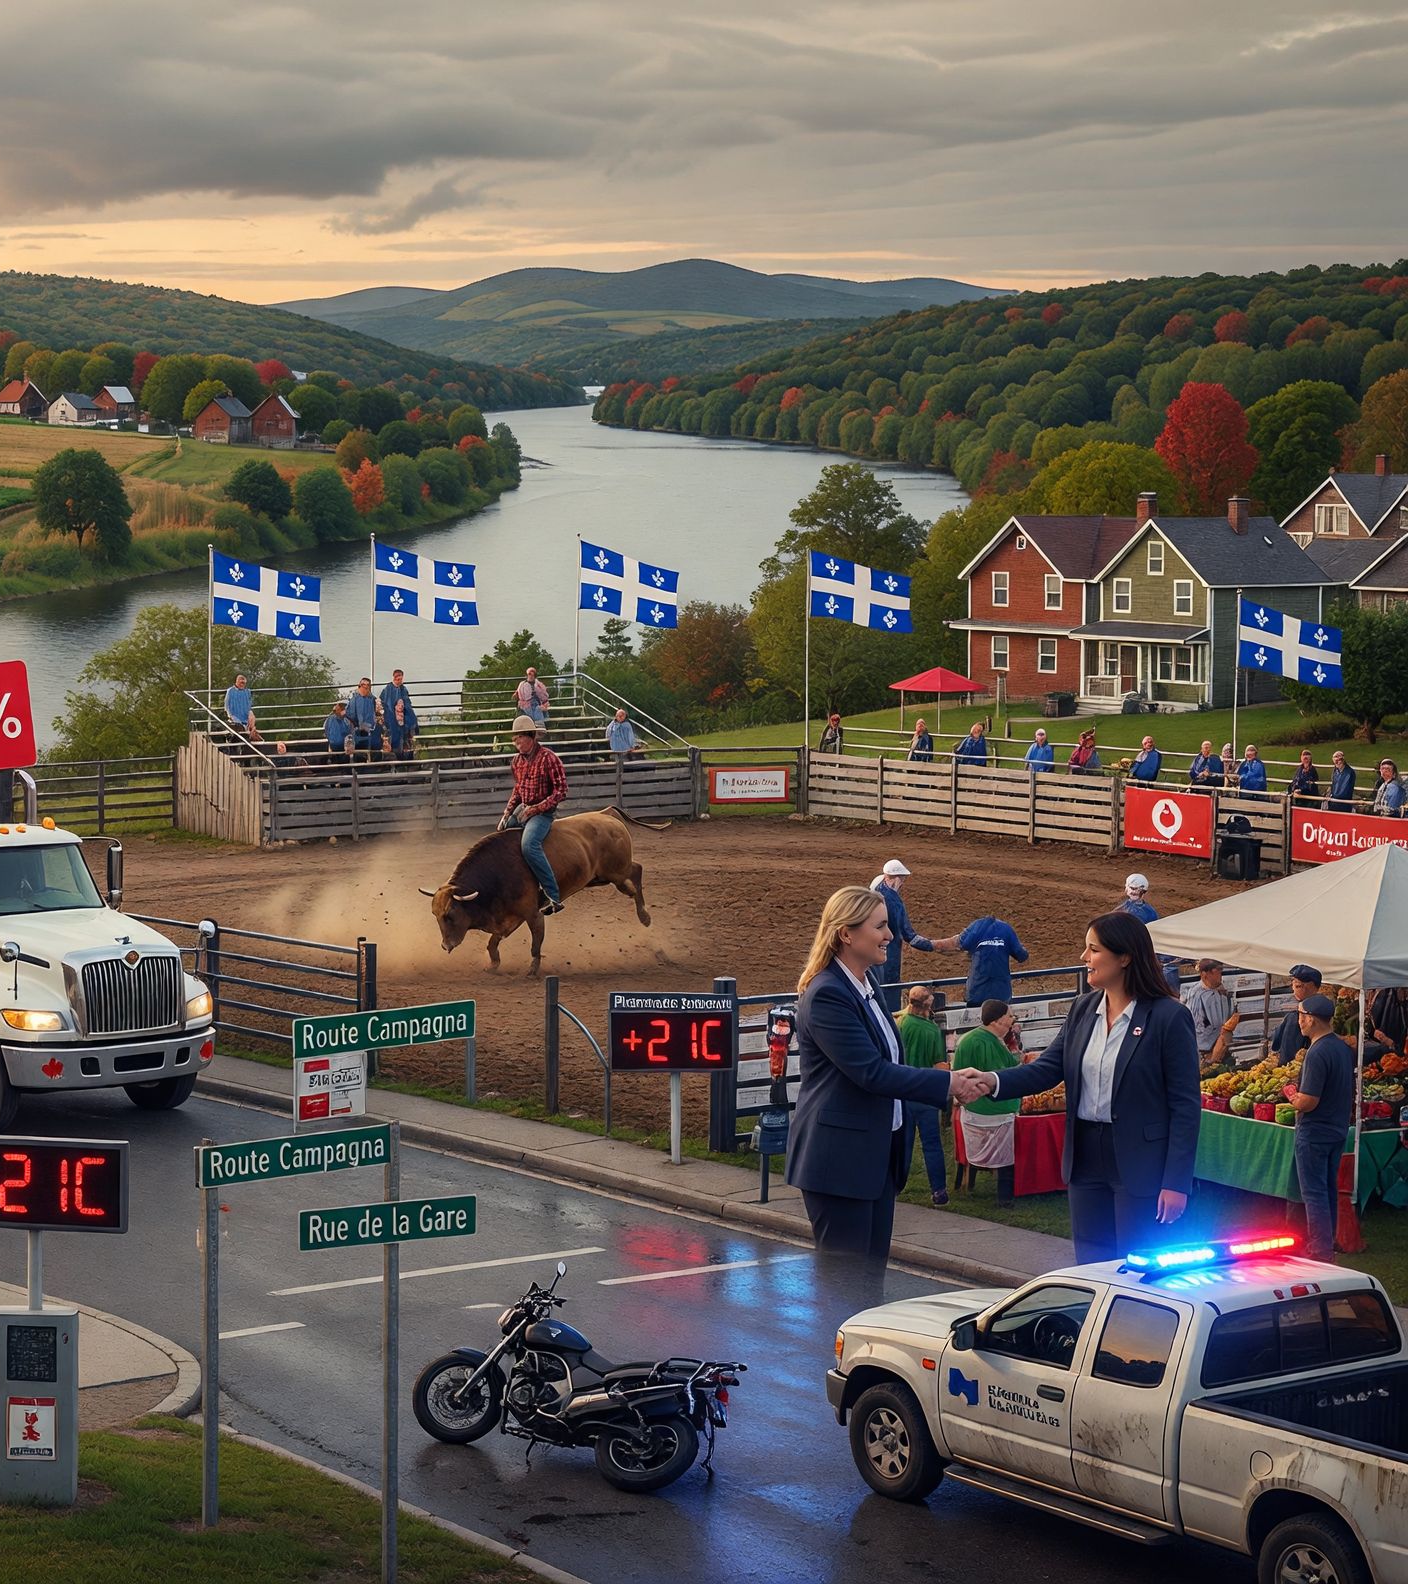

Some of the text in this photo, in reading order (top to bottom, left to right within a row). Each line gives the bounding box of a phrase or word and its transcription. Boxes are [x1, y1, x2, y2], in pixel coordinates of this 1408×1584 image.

[303, 1013, 467, 1050] Route Campagna
[210, 1137, 385, 1180] Route Campagna
[309, 1204, 467, 1244] Rue de la Gare
